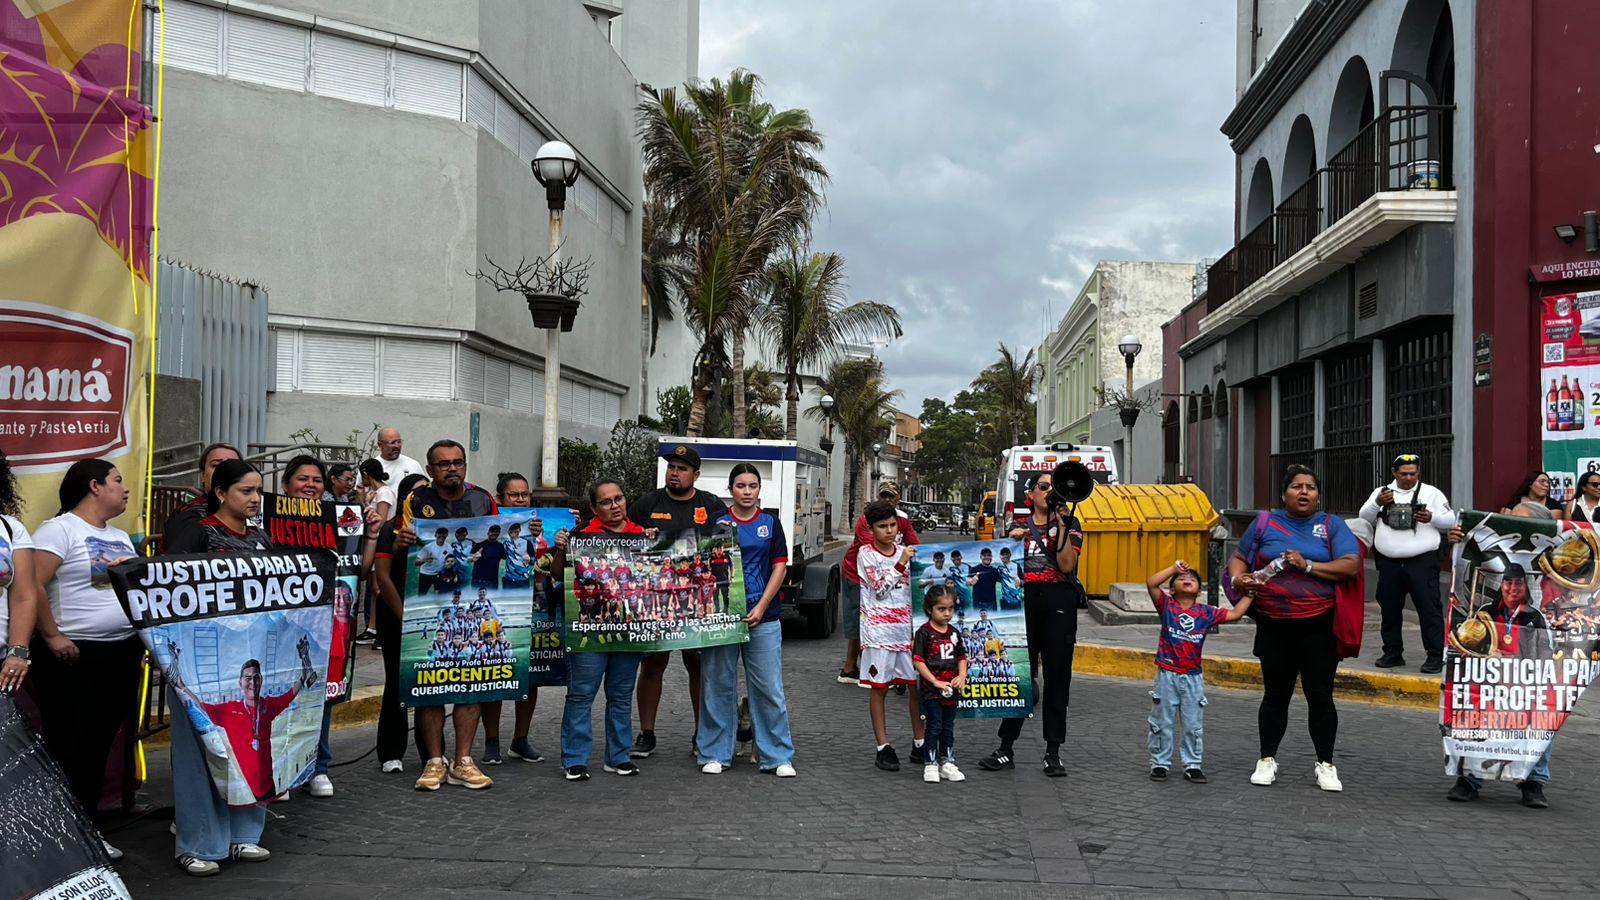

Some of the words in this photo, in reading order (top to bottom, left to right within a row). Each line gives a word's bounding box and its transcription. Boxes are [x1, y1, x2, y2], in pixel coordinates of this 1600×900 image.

[1542, 263, 1563, 274] AQUI
[1562, 270, 1573, 279] LO
[30, 424, 38, 437] y
[38, 420, 110, 434] Pastelería
[1020, 462, 1107, 471] AMBUCIA
[276, 496, 322, 517] EXIGIMOS
[269, 517, 337, 549] JUSTICIA
[140, 558, 253, 586] JUSTICIA
[250, 555, 297, 577] PARA
[296, 554, 317, 573] EL
[127, 580, 236, 621] PROFE
[242, 574, 324, 609] DAGO
[572, 621, 627, 632] Esperamos
[629, 621, 640, 631] tu
[642, 620, 676, 631] regreso
[677, 619, 684, 627] a
[685, 617, 700, 627] las
[701, 613, 741, 626] canchas
[532, 632, 560, 648] TES
[660, 630, 687, 640] Temo
[939, 643, 955, 660] 12
[435, 660, 454, 669] Dago
[1453, 657, 1557, 685] ¡JUSTICIA
[417, 665, 513, 685] INOCENTES
[411, 684, 468, 697] QUEREMOS
[469, 681, 520, 693] JUSTICIA!!
[960, 683, 1019, 698] CENTES
[1452, 684, 1474, 710] EL
[1480, 684, 1548, 711] PROFE
[957, 700, 978, 708] MOS
[980, 698, 1025, 708] JUSTICIA!!
[1452, 710, 1528, 729] ¡LIBERTAD
[1451, 729, 1489, 739] PROFESOR
[1490, 729, 1500, 739] DE
[1501, 730, 1527, 740] FUTBOL
